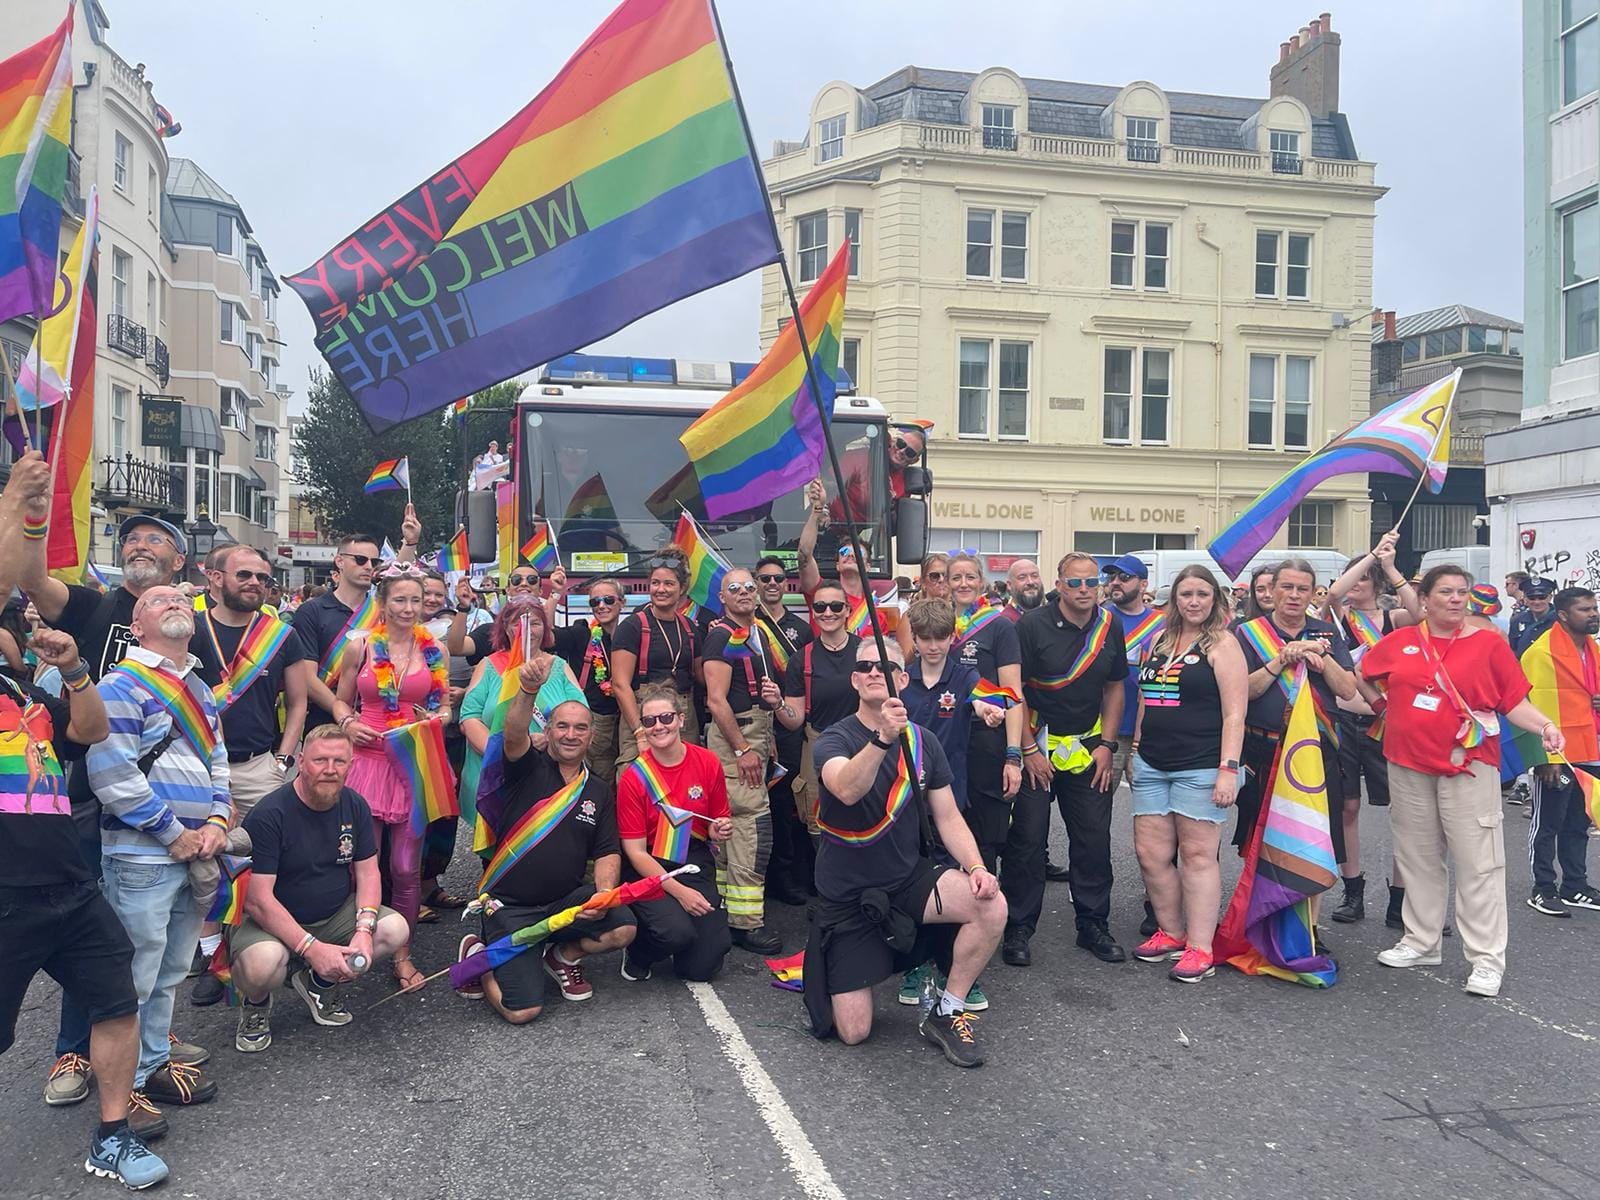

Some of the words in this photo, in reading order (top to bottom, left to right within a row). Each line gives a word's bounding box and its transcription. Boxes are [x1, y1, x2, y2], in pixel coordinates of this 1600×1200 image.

[933, 502, 981, 518] WELL
[986, 504, 1034, 520] DONE
[1090, 506, 1136, 522] WELL
[1140, 508, 1186, 523] DONE
[1525, 550, 1571, 575] RIP
